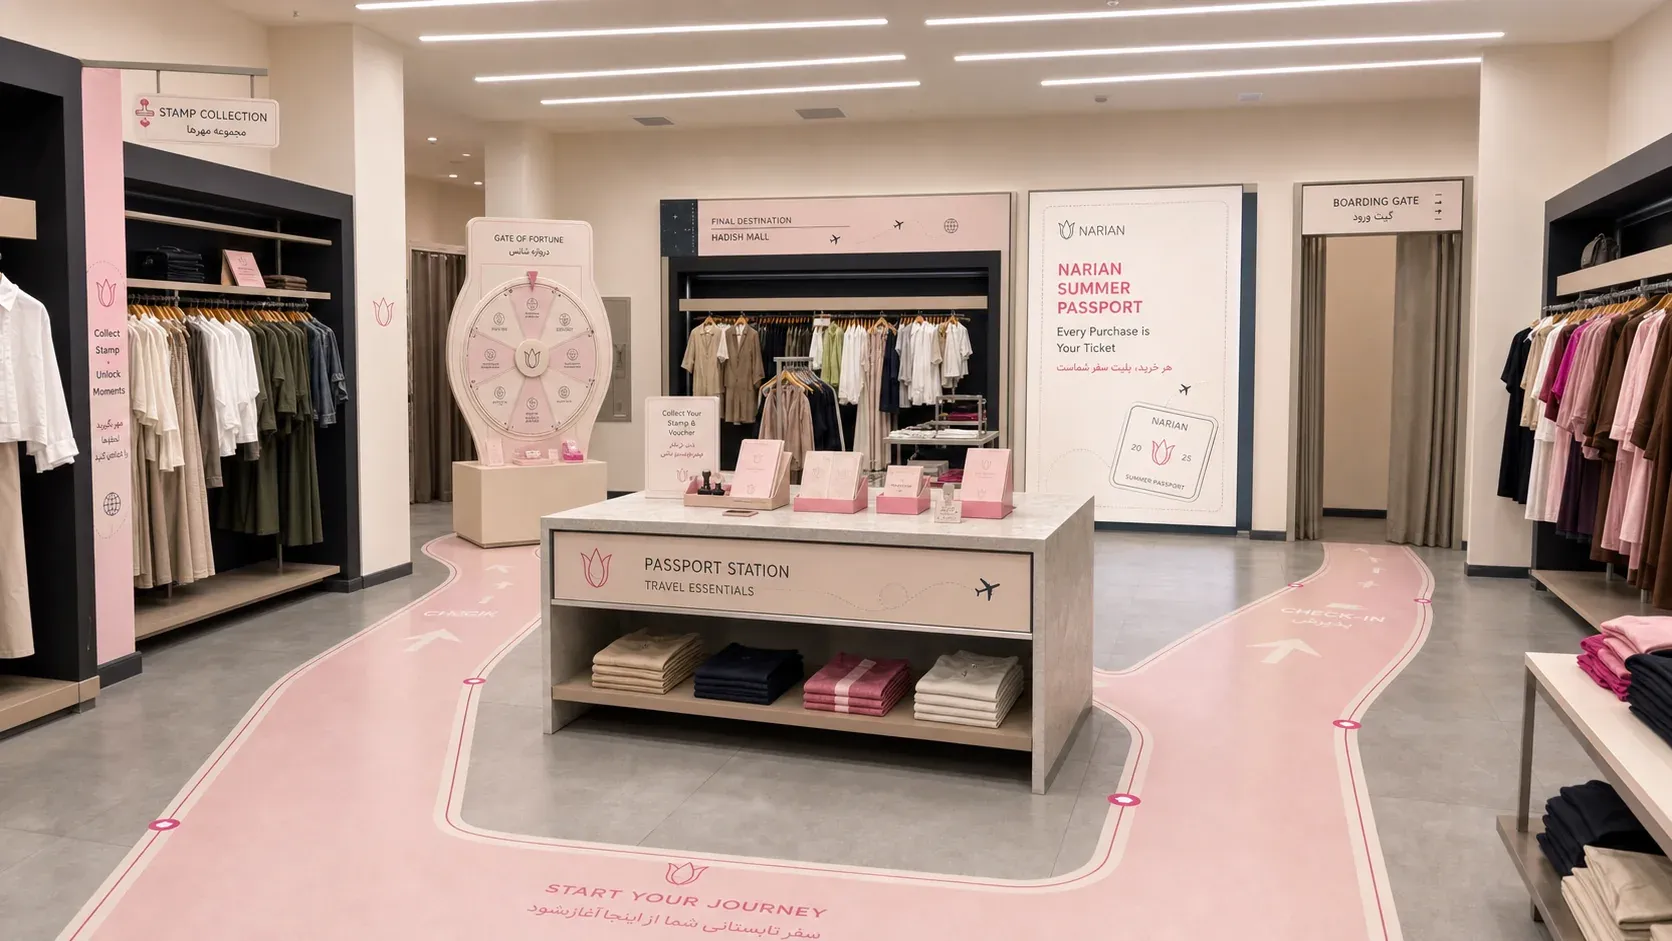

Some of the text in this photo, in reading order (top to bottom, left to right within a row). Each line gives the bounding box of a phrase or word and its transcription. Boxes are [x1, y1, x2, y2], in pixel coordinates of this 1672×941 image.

[159, 107, 268, 122] STAMP COLLECTION
[213, 128, 247, 138] مجموعه
[1333, 196, 1419, 208] BOARDING GATE
[737, 216, 792, 225] DESTINATION
[1353, 214, 1371, 223] ورود
[1079, 225, 1125, 236] NARIAN
[494, 234, 514, 242] GATE
[529, 235, 564, 244] FORTUNE
[711, 233, 770, 241] HADISH MALL
[1058, 262, 1122, 276] NARIAN
[1057, 281, 1131, 295] SUMMER
[1057, 300, 1143, 314] PASSPORT
[94, 329, 121, 337] Collect
[1057, 326, 1150, 339] Every Purchase is
[95, 346, 120, 355] Stamp
[1057, 343, 1116, 353] Your Ticket
[1056, 363, 1090, 372] شماست
[1092, 363, 1109, 374] سفر
[1161, 365, 1173, 374] هر
[96, 370, 121, 379] Unlock
[93, 387, 126, 396] Moments
[662, 409, 685, 417] Collect
[1151, 417, 1189, 432] NARIAN
[1130, 443, 1142, 452] 20
[1125, 473, 1185, 490] SUMMER PASSPORT
[644, 557, 790, 578] PASSPORT STATION
[645, 580, 755, 597] TRAVEL ESSENTIALS
[1281, 607, 1386, 622] CHECK-IN
[545, 884, 828, 918] START YOUR JOURNEY
[603, 910, 643, 925] اینجا
[641, 914, 660, 926] از
[664, 916, 699, 928] شما
[702, 921, 781, 938] تابستانی
[781, 928, 821, 940] سفر
